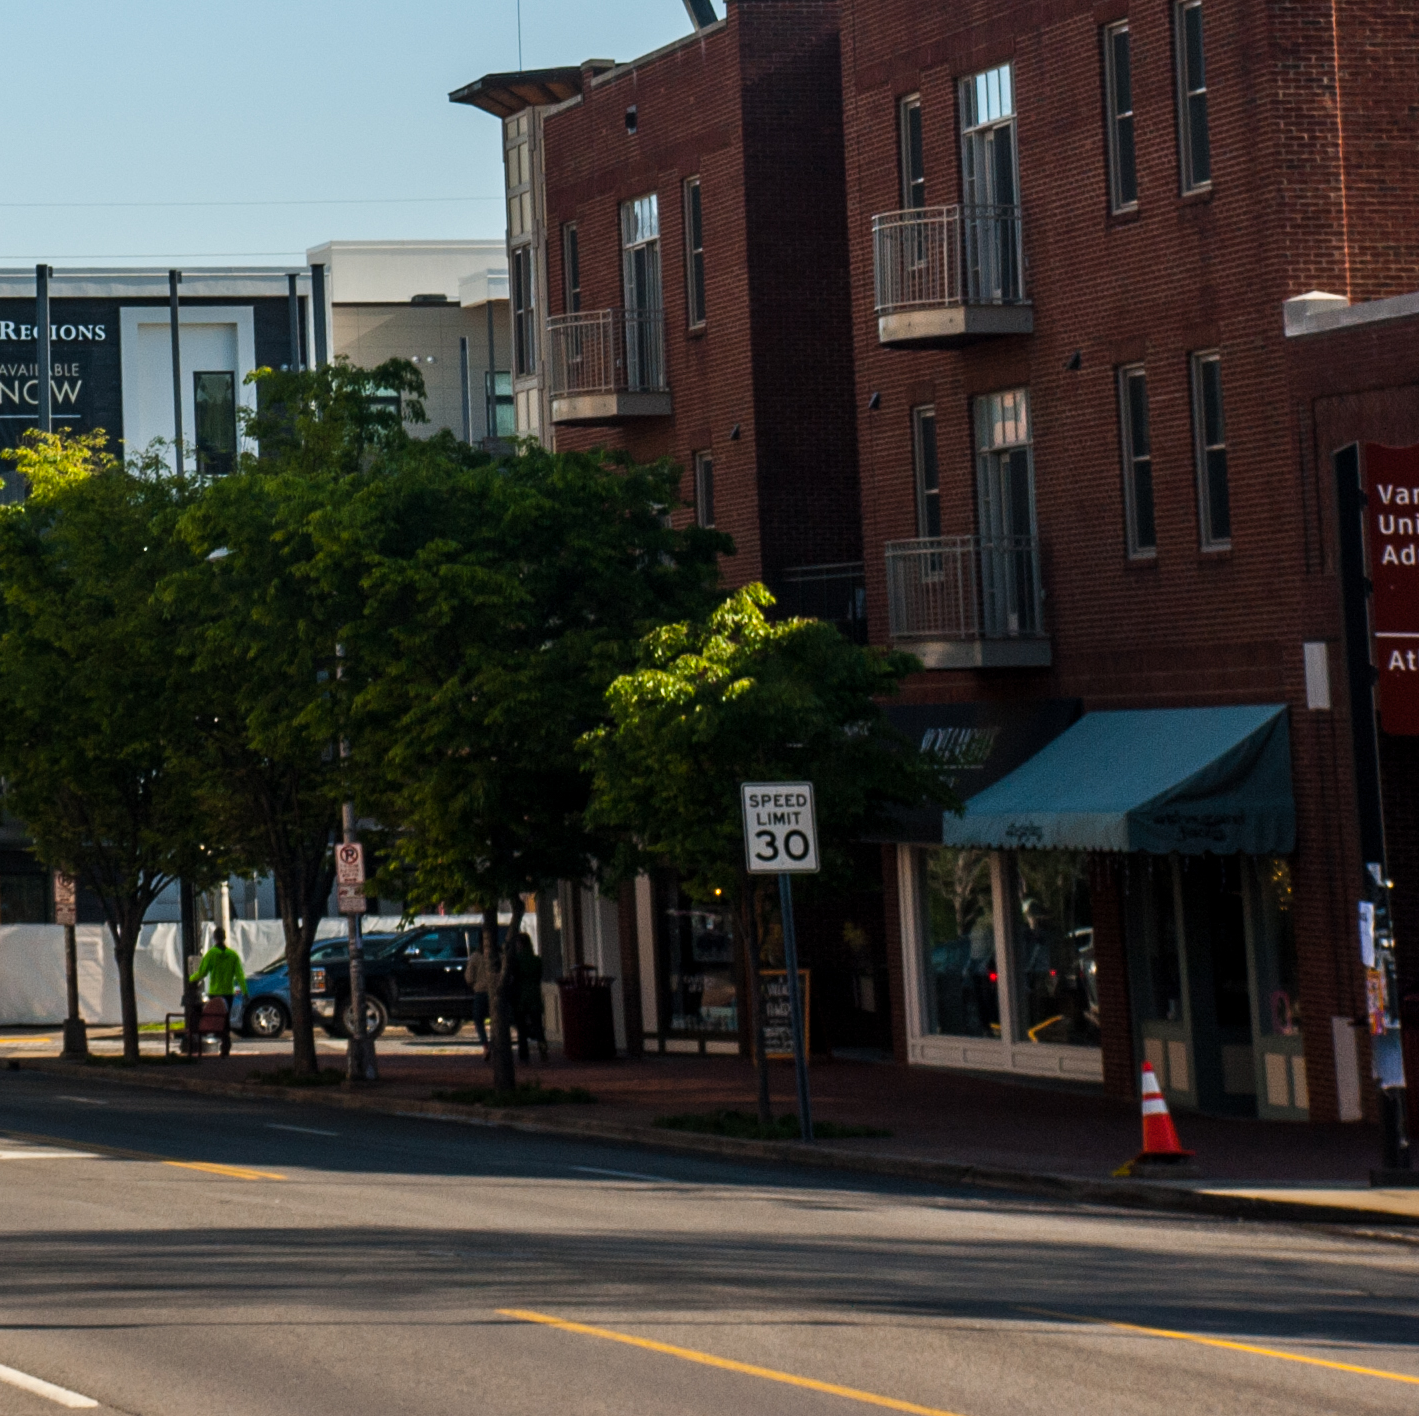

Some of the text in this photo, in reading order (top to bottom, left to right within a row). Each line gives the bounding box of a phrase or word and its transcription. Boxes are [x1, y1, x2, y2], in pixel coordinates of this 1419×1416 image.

[749, 793, 807, 808] SPEED
[756, 811, 801, 826] LIMIT
[755, 828, 810, 862] 30
